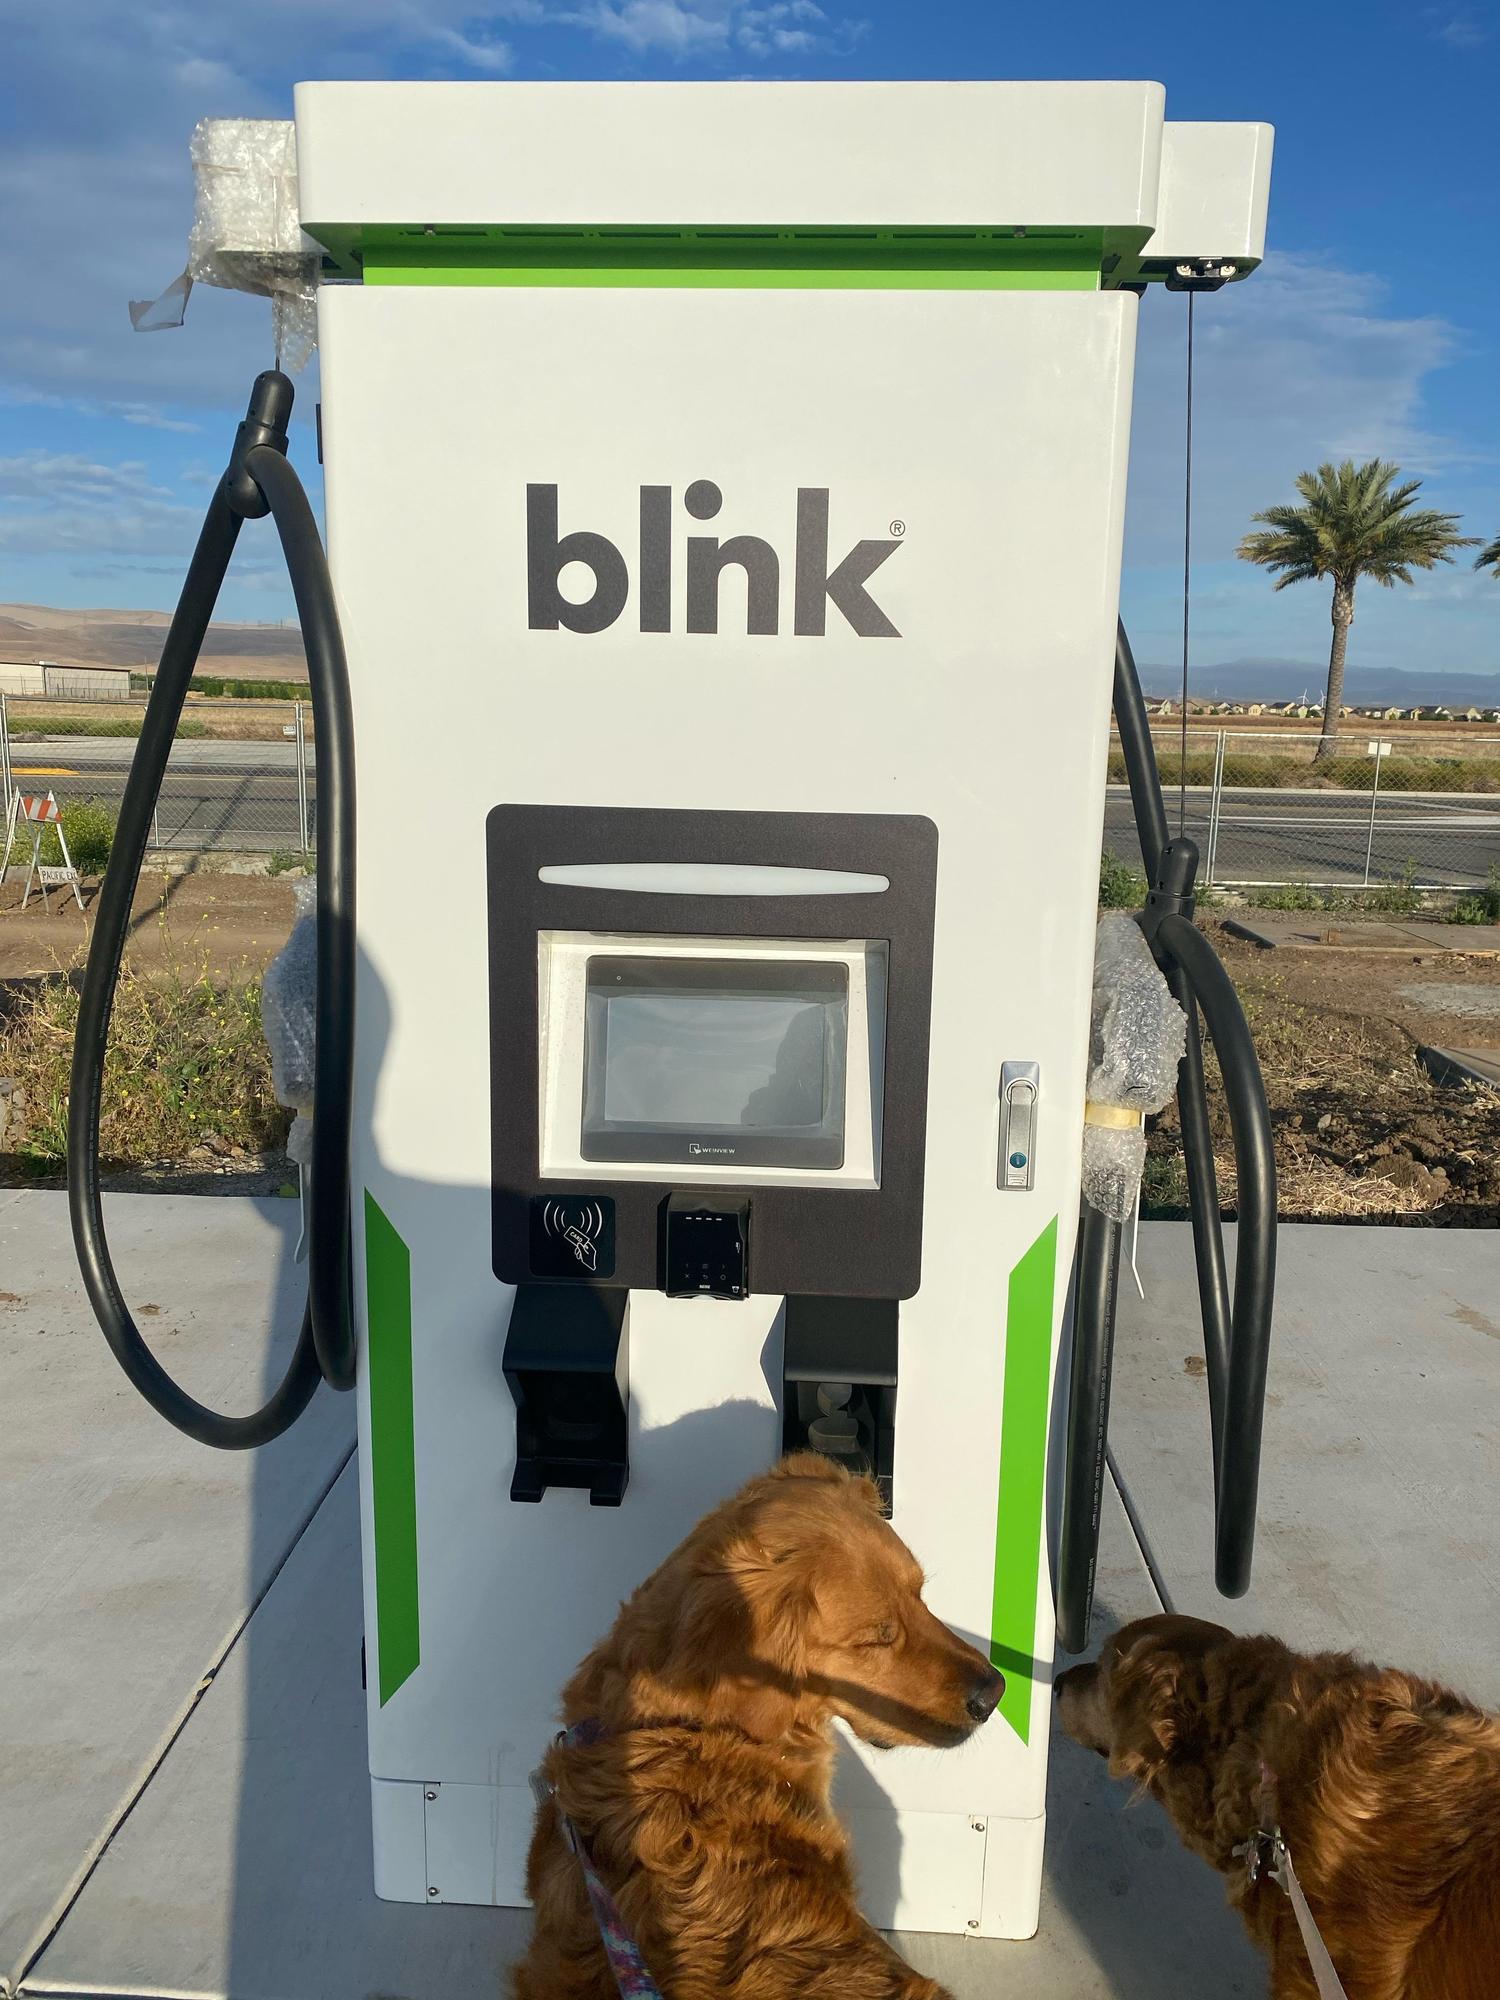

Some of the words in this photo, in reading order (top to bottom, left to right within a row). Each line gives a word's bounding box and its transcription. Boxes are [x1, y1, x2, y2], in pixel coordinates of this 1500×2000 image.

[526, 479, 904, 638] blink
[42, 870, 65, 881] PACIFIC
[569, 1231, 583, 1243] CARD
